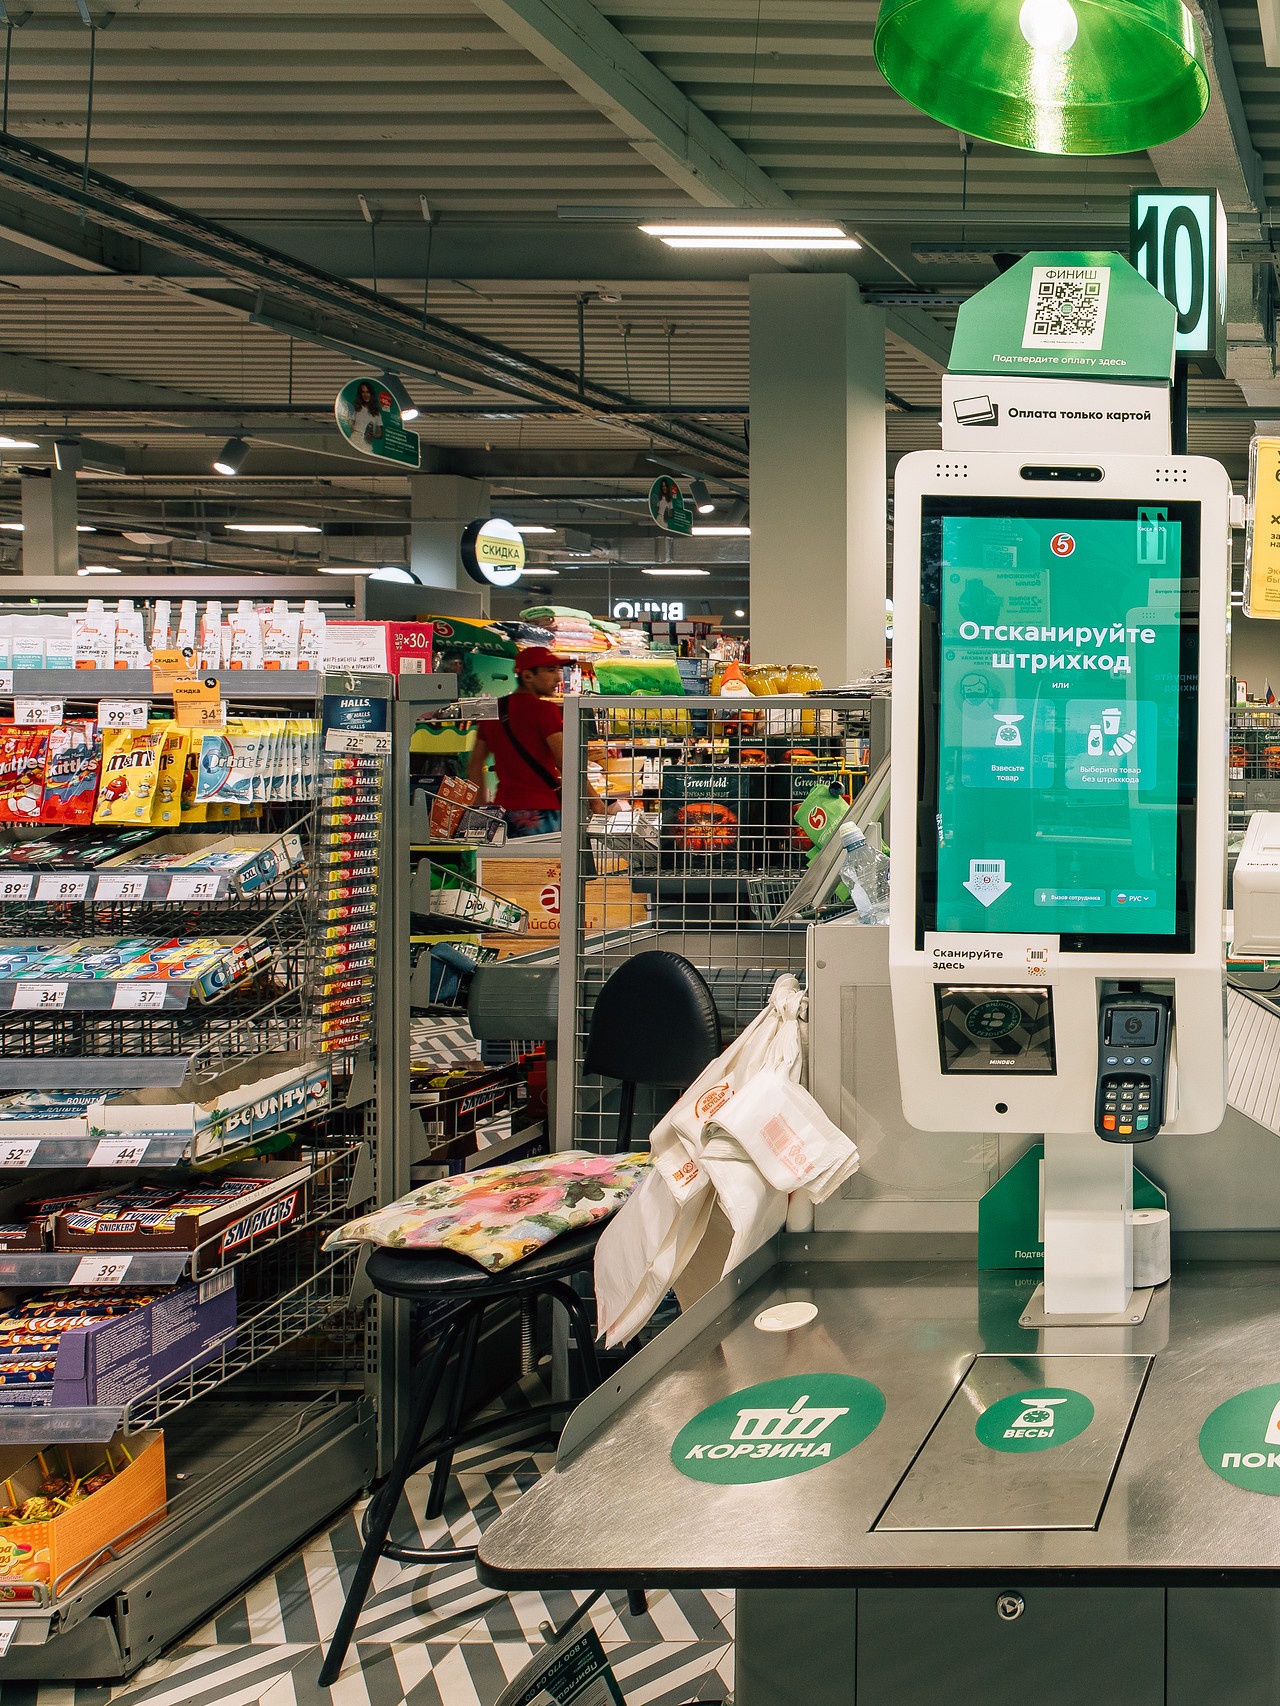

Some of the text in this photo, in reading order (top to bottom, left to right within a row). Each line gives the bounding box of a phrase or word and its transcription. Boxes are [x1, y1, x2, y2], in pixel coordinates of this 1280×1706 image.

[1045, 269, 1098, 280] ФИНИШ
[1137, 206, 1204, 334] 10
[992, 354, 1127, 367] Подтвердите оплату здесь
[1008, 408, 1151, 422] Оплата только картой
[482, 544, 520, 559] СКИДКА
[959, 621, 1156, 648] Отсканируйте
[992, 653, 1132, 674] штрихкод
[340, 699, 371, 708] HALLS
[27, 709, 43, 719] 49
[109, 712, 125, 722] 99
[201, 709, 216, 719] 34
[347, 738, 359, 747] 22
[376, 739, 387, 748] 22
[0, 756, 45, 774] kittles
[202, 749, 255, 774] Orbit
[49, 758, 97, 776] kittles
[991, 764, 1025, 773] Взвесьте
[1080, 765, 1142, 775] Выберите товар
[684, 776, 727, 788] Greenfield
[996, 774, 1019, 783] товар
[1081, 775, 1140, 784] без штрихкода
[242, 851, 288, 880] XXL Orbit
[5, 884, 21, 894] 89
[60, 884, 76, 894] 89
[121, 884, 135, 894] 51
[194, 884, 207, 894] 51
[1068, 894, 1101, 902] сотрудника
[351, 905, 374, 913] HALLS
[349, 941, 372, 950] HALLS
[932, 948, 1004, 960] Сканируйте
[932, 961, 965, 971] здесь
[211, 958, 246, 988] Orbit
[341, 980, 361, 988] HALLS
[41, 992, 57, 1002] 34
[140, 992, 154, 1002] 37
[339, 1017, 360, 1025] HALLS
[226, 1082, 306, 1132] BOUNTY
[6, 1150, 24, 1160] 52
[117, 1149, 136, 1159] 44
[225, 1194, 296, 1247] SNICKERS
[99, 1222, 136, 1233] SNICKERS
[98, 1265, 117, 1276] 39
[1003, 1427, 1055, 1439] ВЕСЫ
[685, 1441, 832, 1460] КОРЗИНА
[564, 1645, 580, 1662] 800
